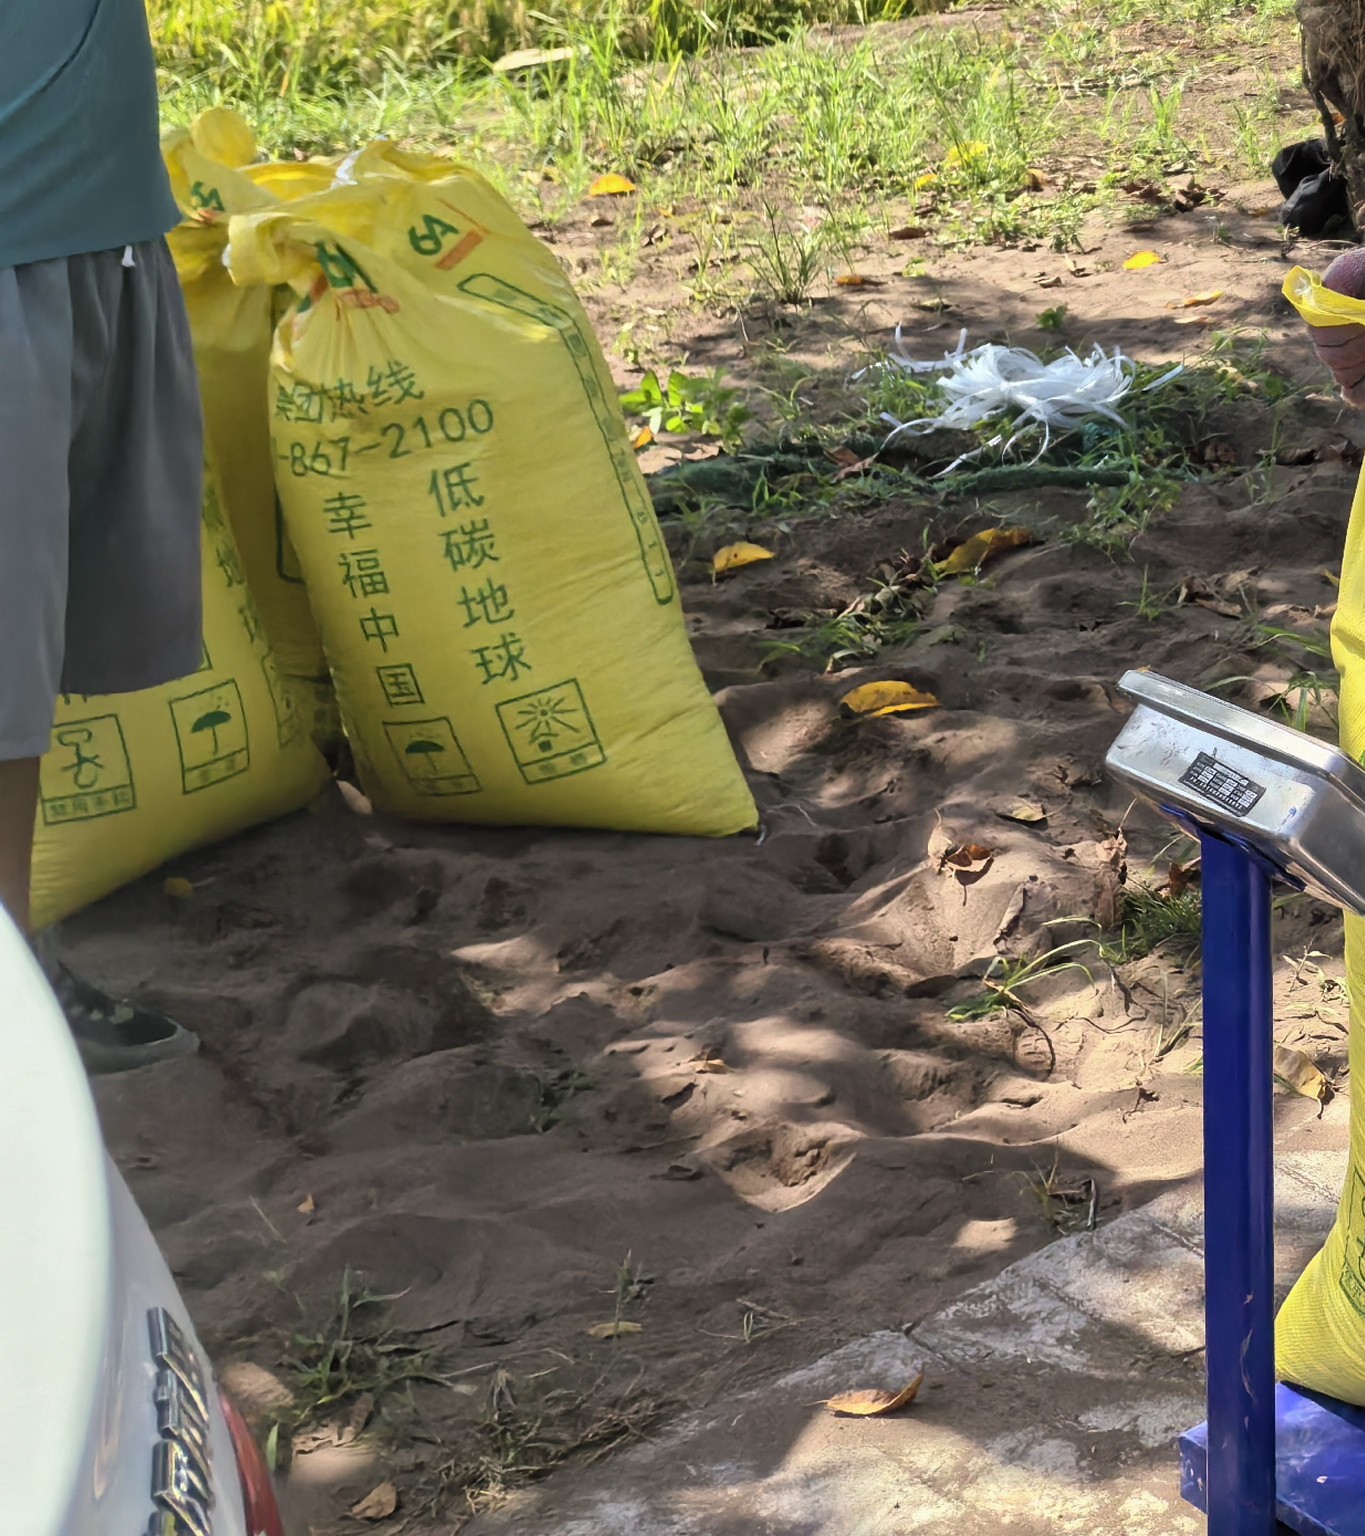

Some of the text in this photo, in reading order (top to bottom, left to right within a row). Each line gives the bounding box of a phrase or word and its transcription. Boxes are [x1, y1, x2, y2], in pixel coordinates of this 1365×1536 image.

[273, 399, 494, 477] -867-2100
[274, 360, 425, 424] 集团热线
[324, 492, 426, 708] 幸福中国
[429, 461, 532, 686] 低碳地球
